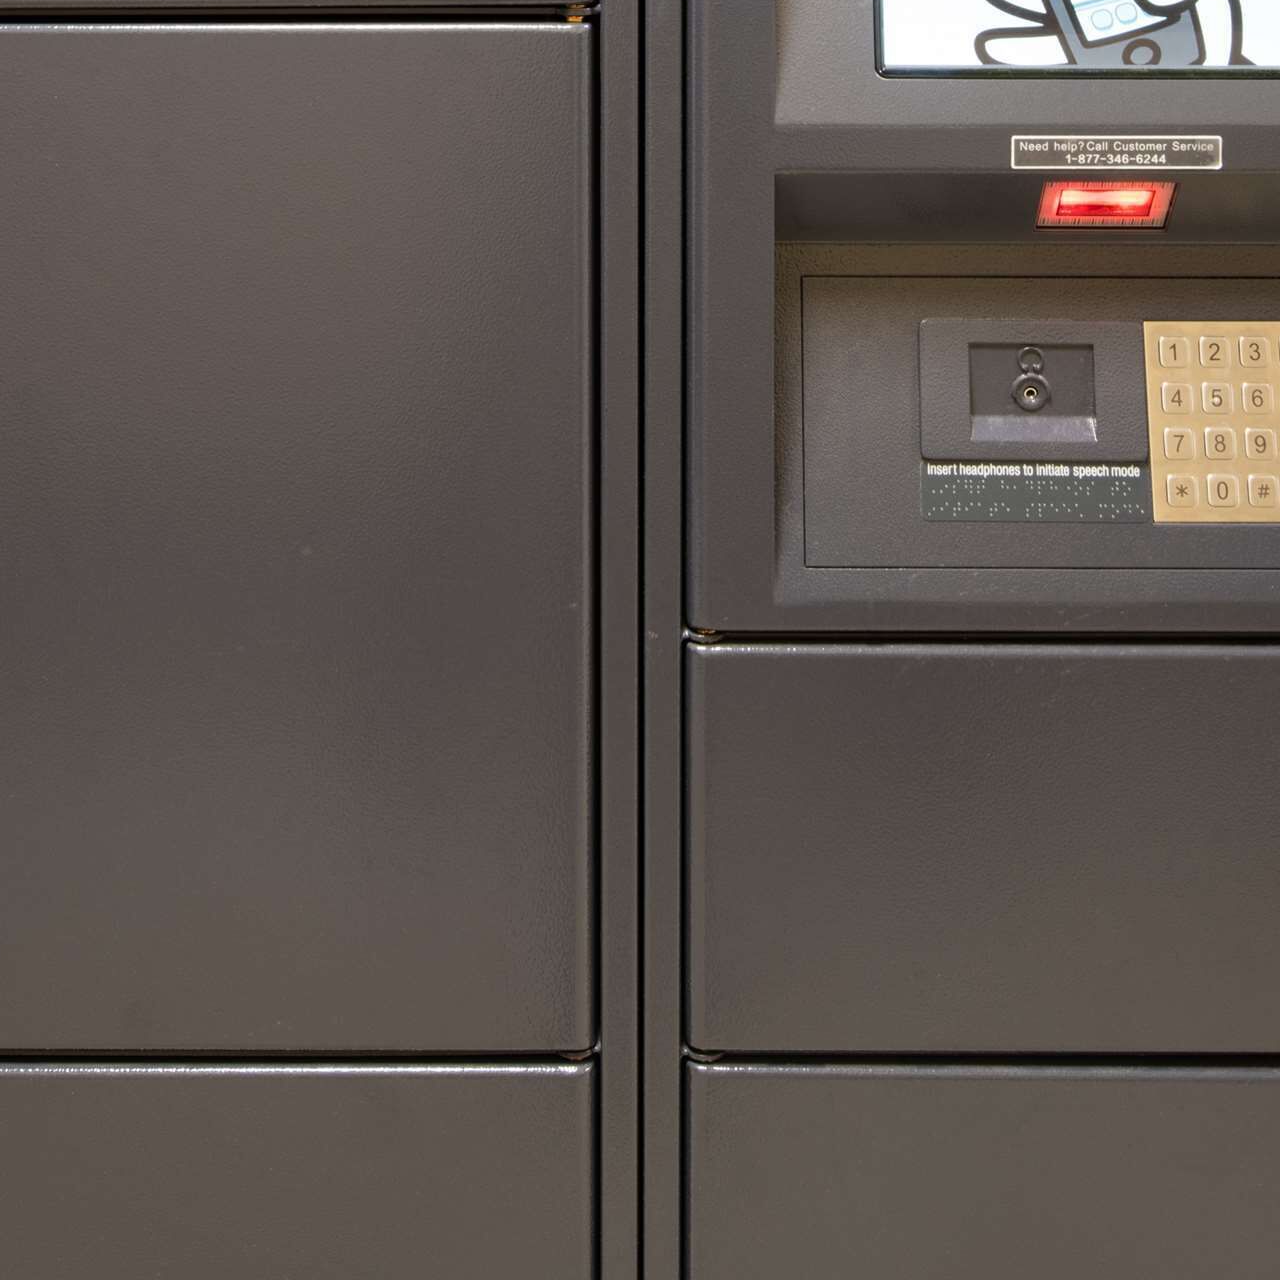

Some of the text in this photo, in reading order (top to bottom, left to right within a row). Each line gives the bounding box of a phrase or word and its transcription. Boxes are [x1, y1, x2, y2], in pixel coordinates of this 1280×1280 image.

[1019, 141, 1214, 154] Need help? Call Customer Service
[1064, 154, 1167, 164] 1-877-346-6244
[1169, 343, 1178, 361] 1
[1208, 343, 1221, 361] 2
[1249, 343, 1261, 361] 3
[1171, 389, 1183, 407] 4
[1211, 389, 1223, 407] 5
[1251, 389, 1264, 407] 6
[1173, 435, 1185, 453] 7
[1214, 434, 1226, 453] 8
[1254, 435, 1267, 453] 9
[927, 463, 1141, 479] Insert headphones to initiate speech mode
[1217, 481, 1229, 500] 0
